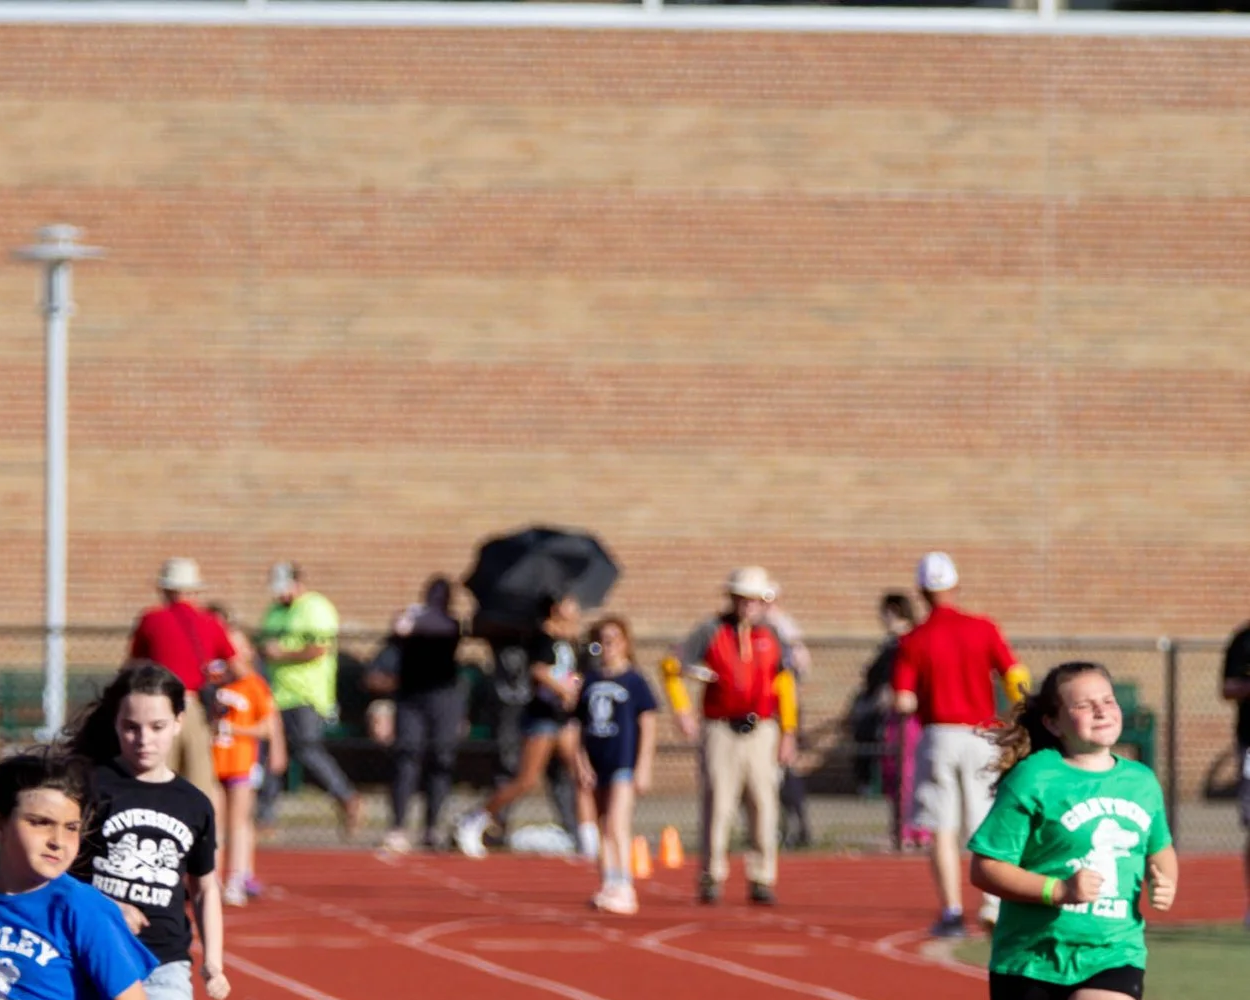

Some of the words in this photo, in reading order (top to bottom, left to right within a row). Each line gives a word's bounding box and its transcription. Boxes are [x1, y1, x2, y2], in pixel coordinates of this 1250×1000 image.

[101, 807, 194, 853] RIVERSIDE
[92, 873, 129, 899] RUN
[128, 882, 173, 908] CLUB
